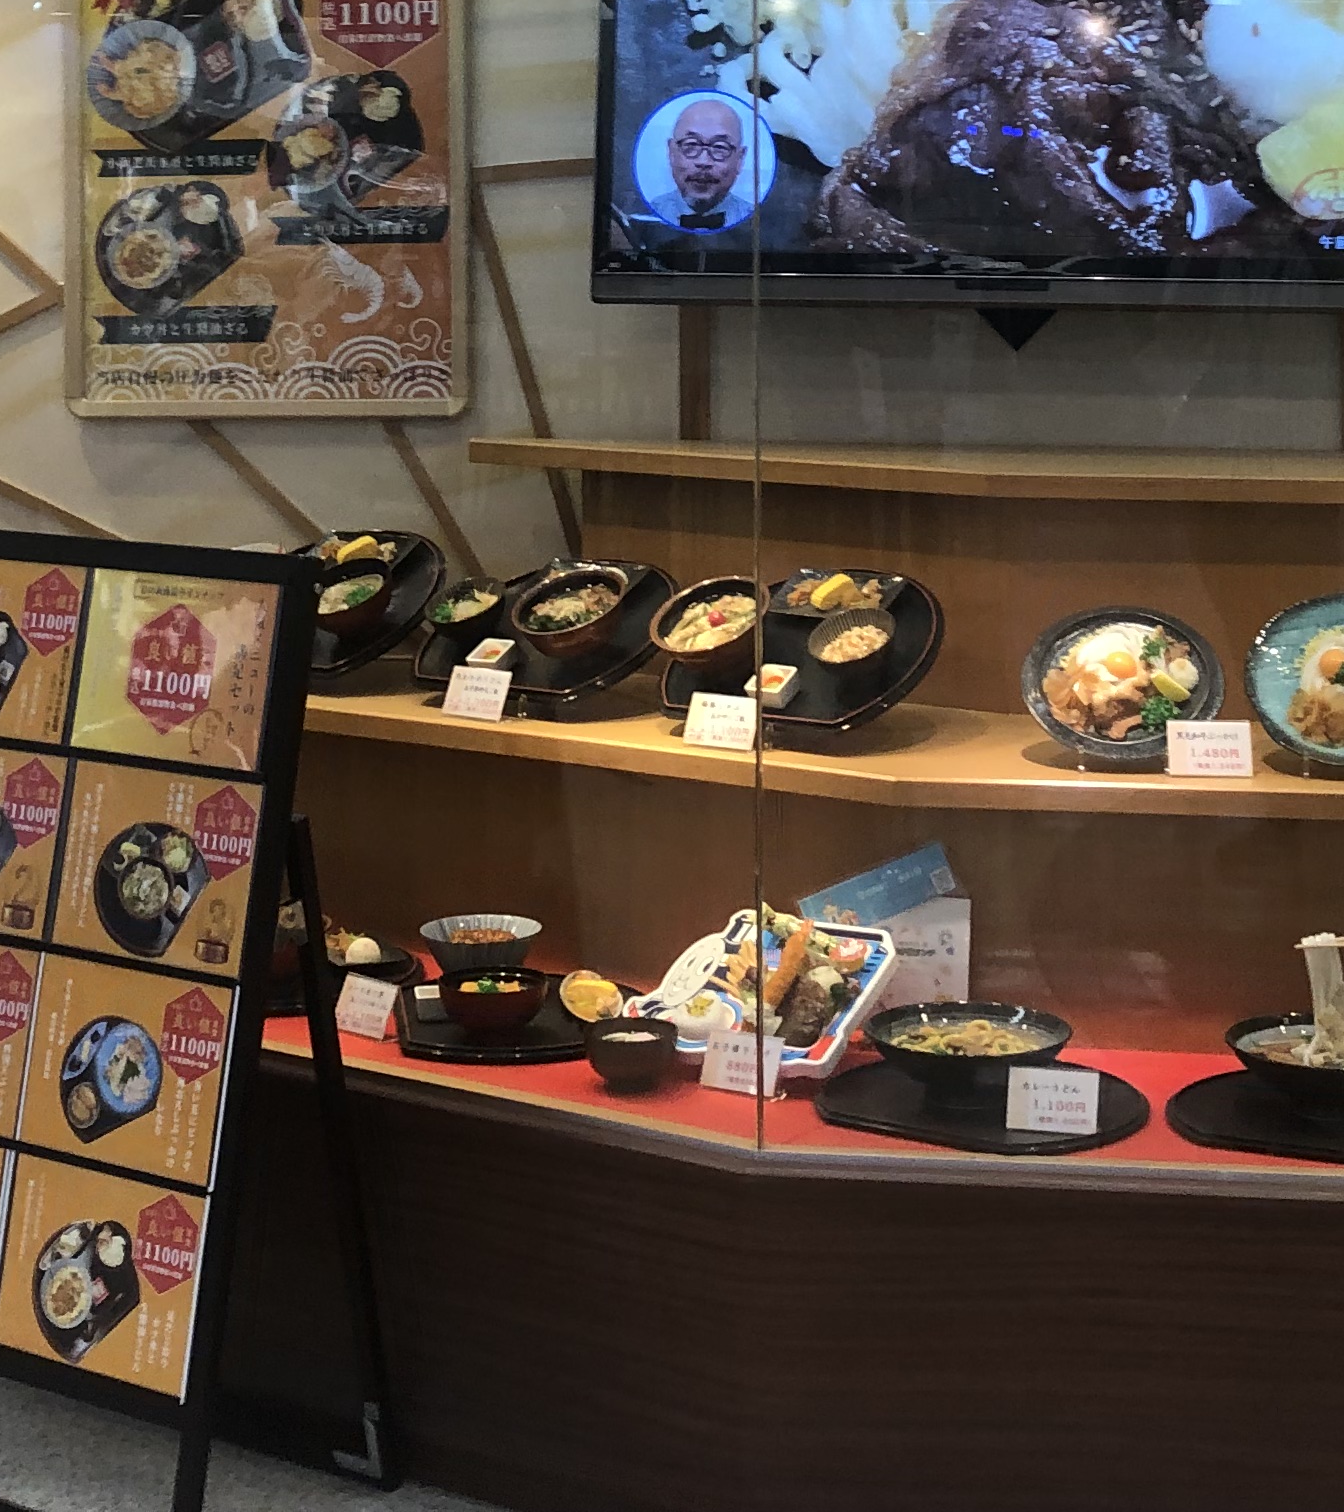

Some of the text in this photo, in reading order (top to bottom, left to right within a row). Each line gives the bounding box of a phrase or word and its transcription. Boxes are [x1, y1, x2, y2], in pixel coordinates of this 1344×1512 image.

[339, 0, 439, 26] 1100円
[31, 611, 78, 633] 1100円
[143, 668, 212, 699] 1100円
[10, 802, 57, 825] 1100円
[203, 833, 253, 857] 1100円
[170, 1033, 221, 1062] 1100円
